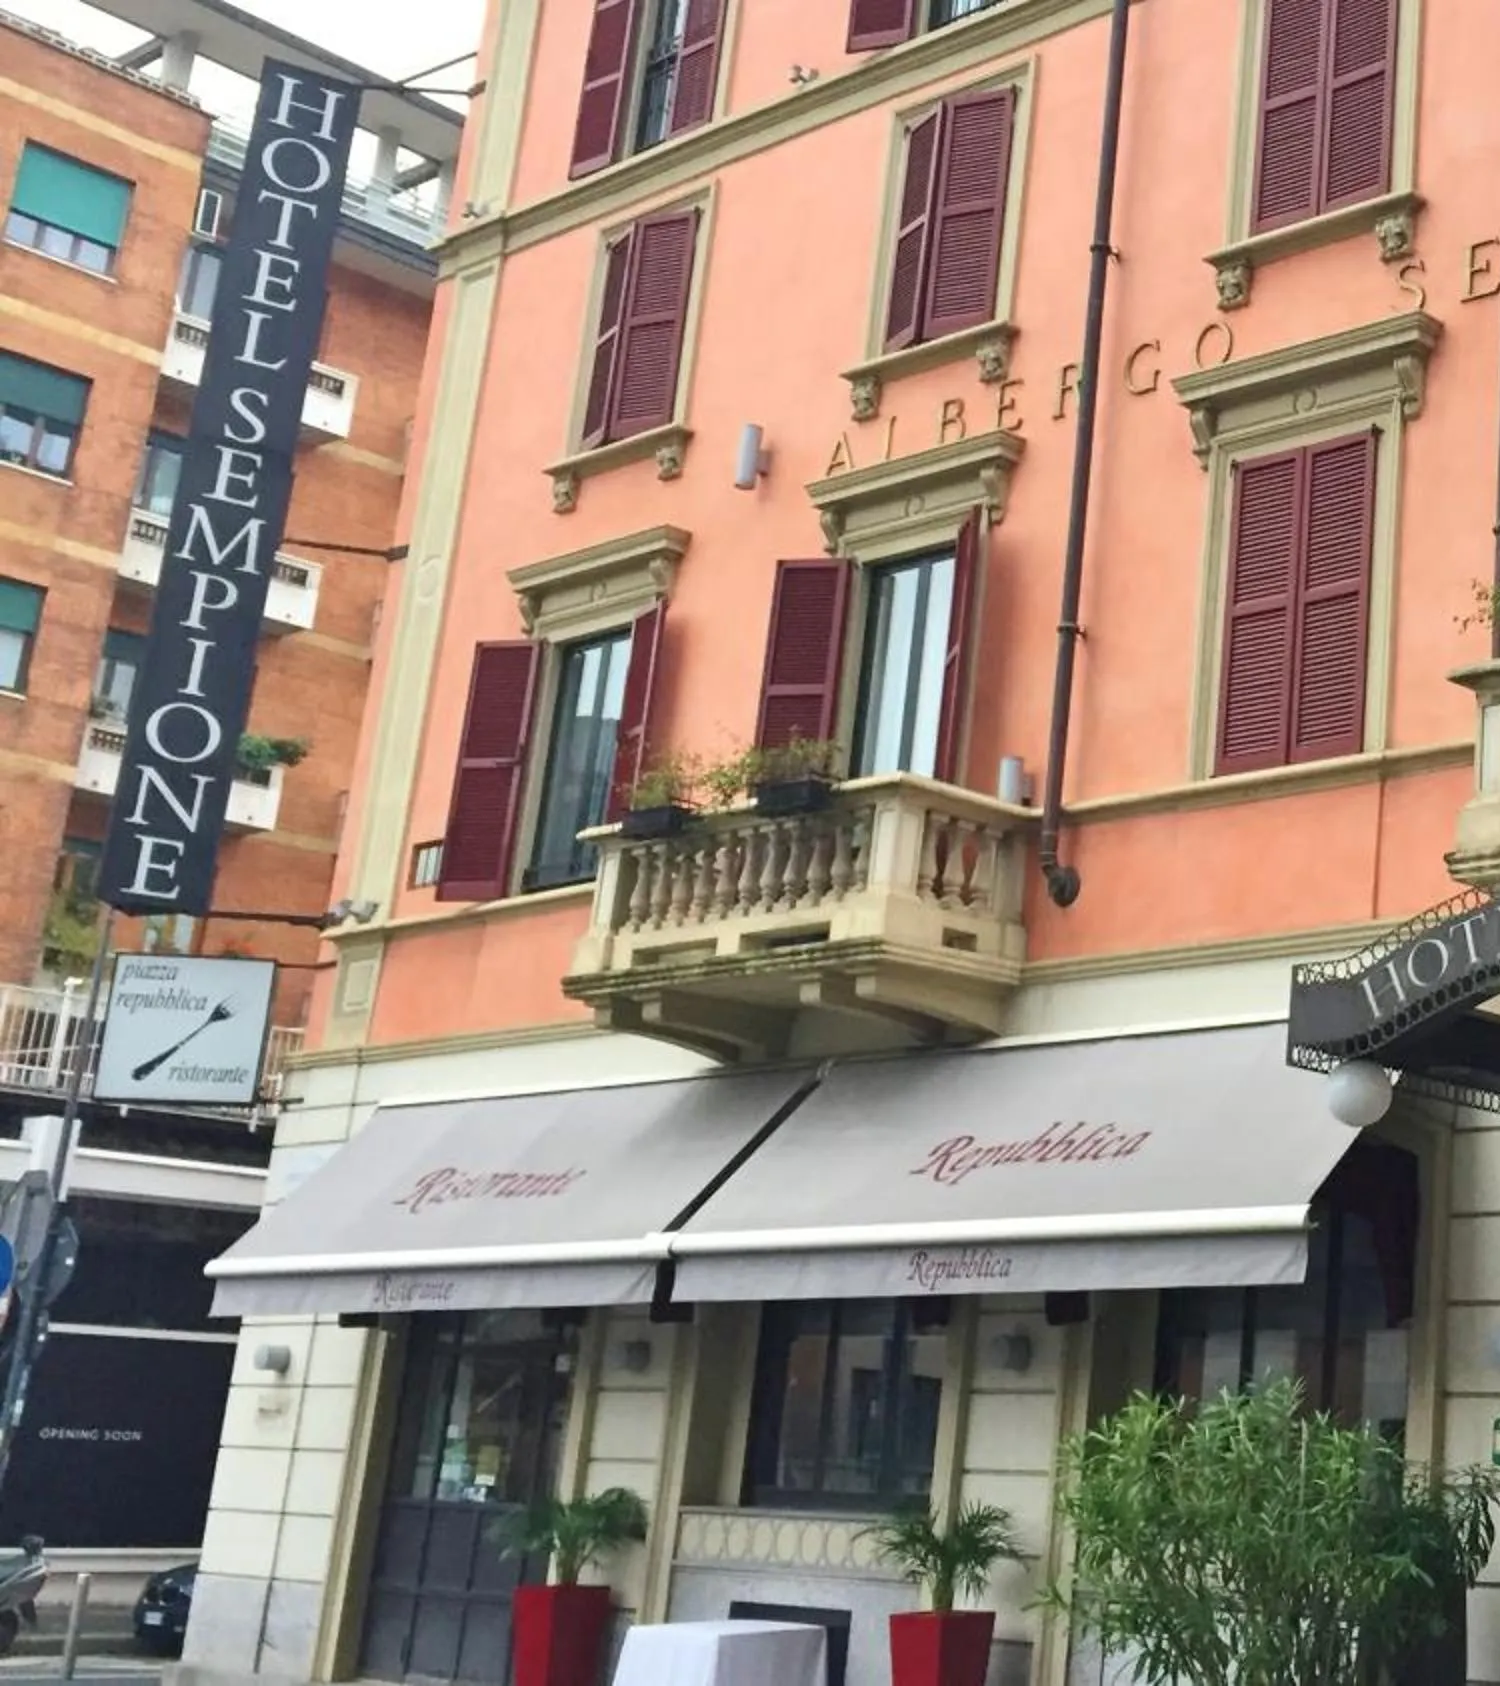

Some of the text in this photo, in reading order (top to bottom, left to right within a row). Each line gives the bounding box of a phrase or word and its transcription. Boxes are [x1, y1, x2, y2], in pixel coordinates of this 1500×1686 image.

[119, 73, 346, 901] HOTEL SEMPIONE
[119, 959, 180, 985] piazza
[115, 986, 209, 1014] repubblica
[168, 1058, 250, 1084] ristorante
[909, 1121, 1154, 1187] Repubblica
[907, 1248, 1014, 1291] Repubblica
[38, 1427, 143, 1442] OPENING SOON
